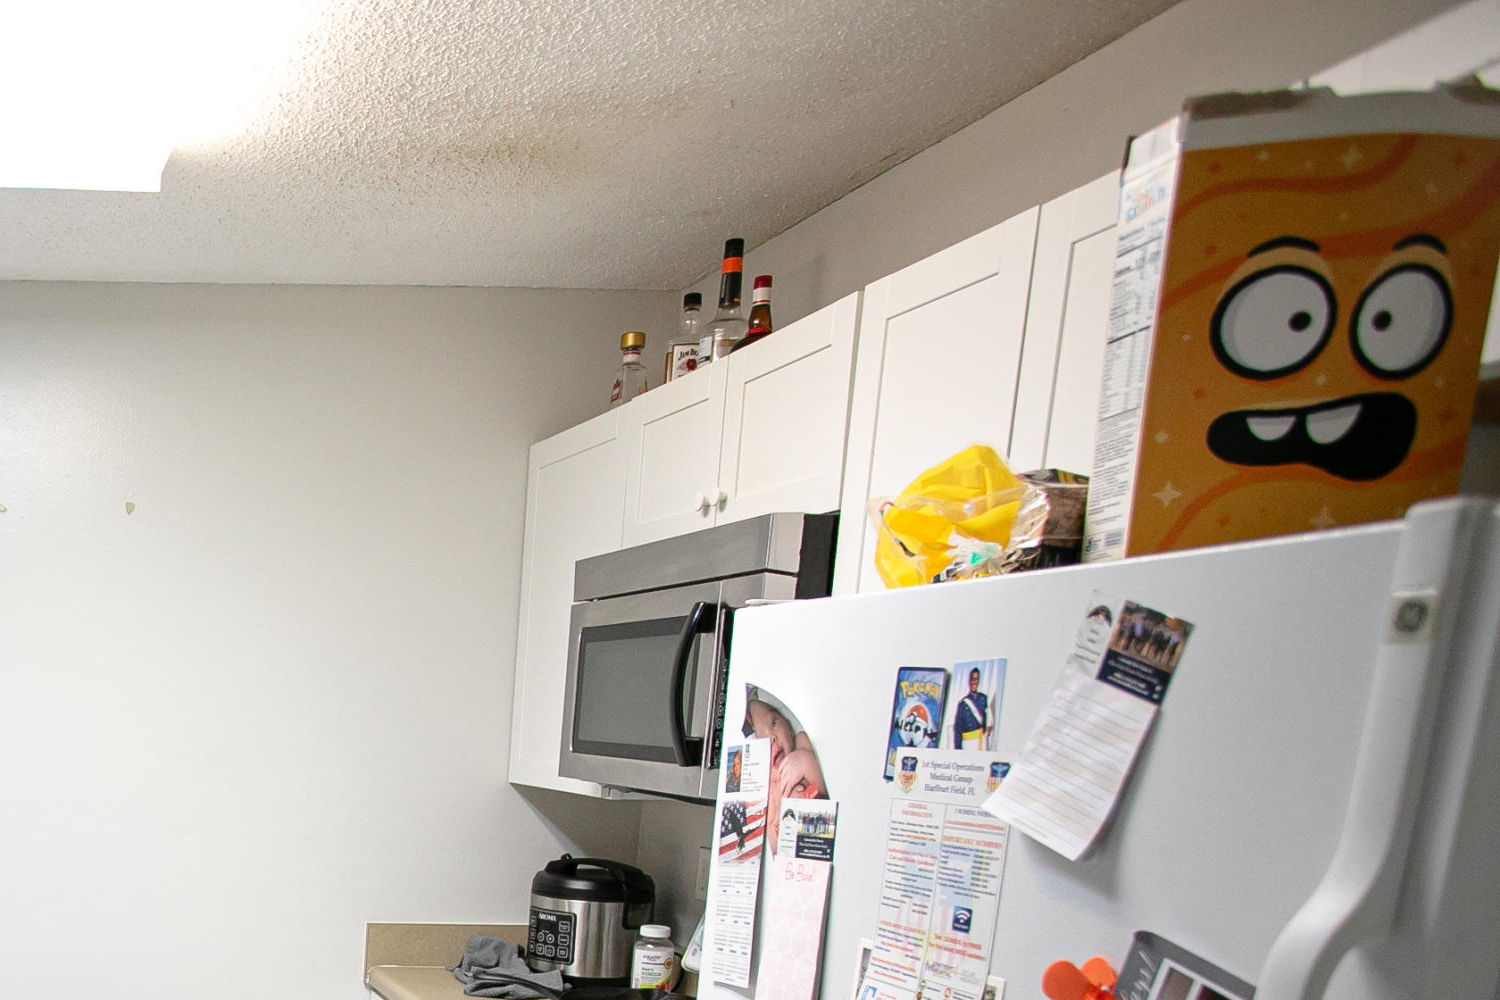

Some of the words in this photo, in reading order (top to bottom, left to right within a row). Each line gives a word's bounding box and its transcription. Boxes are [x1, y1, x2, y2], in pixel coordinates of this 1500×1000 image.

[930, 760, 951, 771] Special
[952, 761, 985, 772] Operations
[930, 772, 953, 781] Medical
[954, 774, 973, 785] Group
